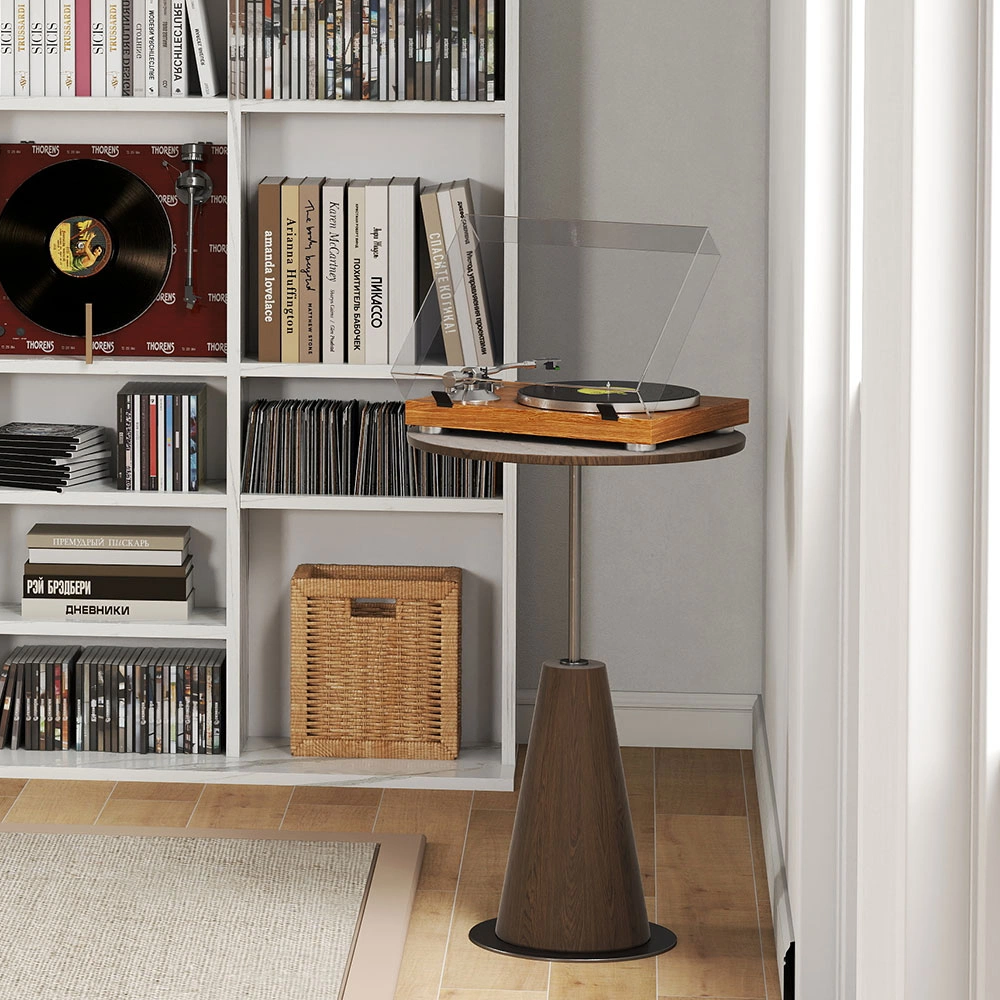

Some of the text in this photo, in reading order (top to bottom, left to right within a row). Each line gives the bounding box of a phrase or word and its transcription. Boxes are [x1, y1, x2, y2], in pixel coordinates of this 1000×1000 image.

[1, 22, 13, 55] SICIS
[17, 3, 26, 52] TRUSSARDI
[31, 22, 43, 55] SICIS
[46, 22, 58, 55] SICIS
[63, 3, 72, 52] TRUSSARDI
[92, 22, 104, 55] SICIS
[32, 145, 60, 157] THORENS
[91, 145, 120, 158] THORENS
[151, 145, 179, 158] THORENS
[300, 200, 317, 292] The body beyond
[325, 201, 340, 283] Karen McCartney
[264, 230, 273, 323] amanda lovelace
[283, 218, 297, 334] Arianna Huffington
[353, 258, 361, 351] ПОХИТИТЕЛЬ БАБОЧЕК
[371, 276, 383, 329] ПИКАССО
[26, 340, 54, 354] THORENS
[146, 341, 175, 354] THORENS
[53, 537, 150, 547] ПРЕМУДРЫЙ ПИСКАРЬ
[27, 577, 91, 596] РЭЙ БРЭДБЕРИ
[65, 605, 130, 616] ДНЕВНИКИ
